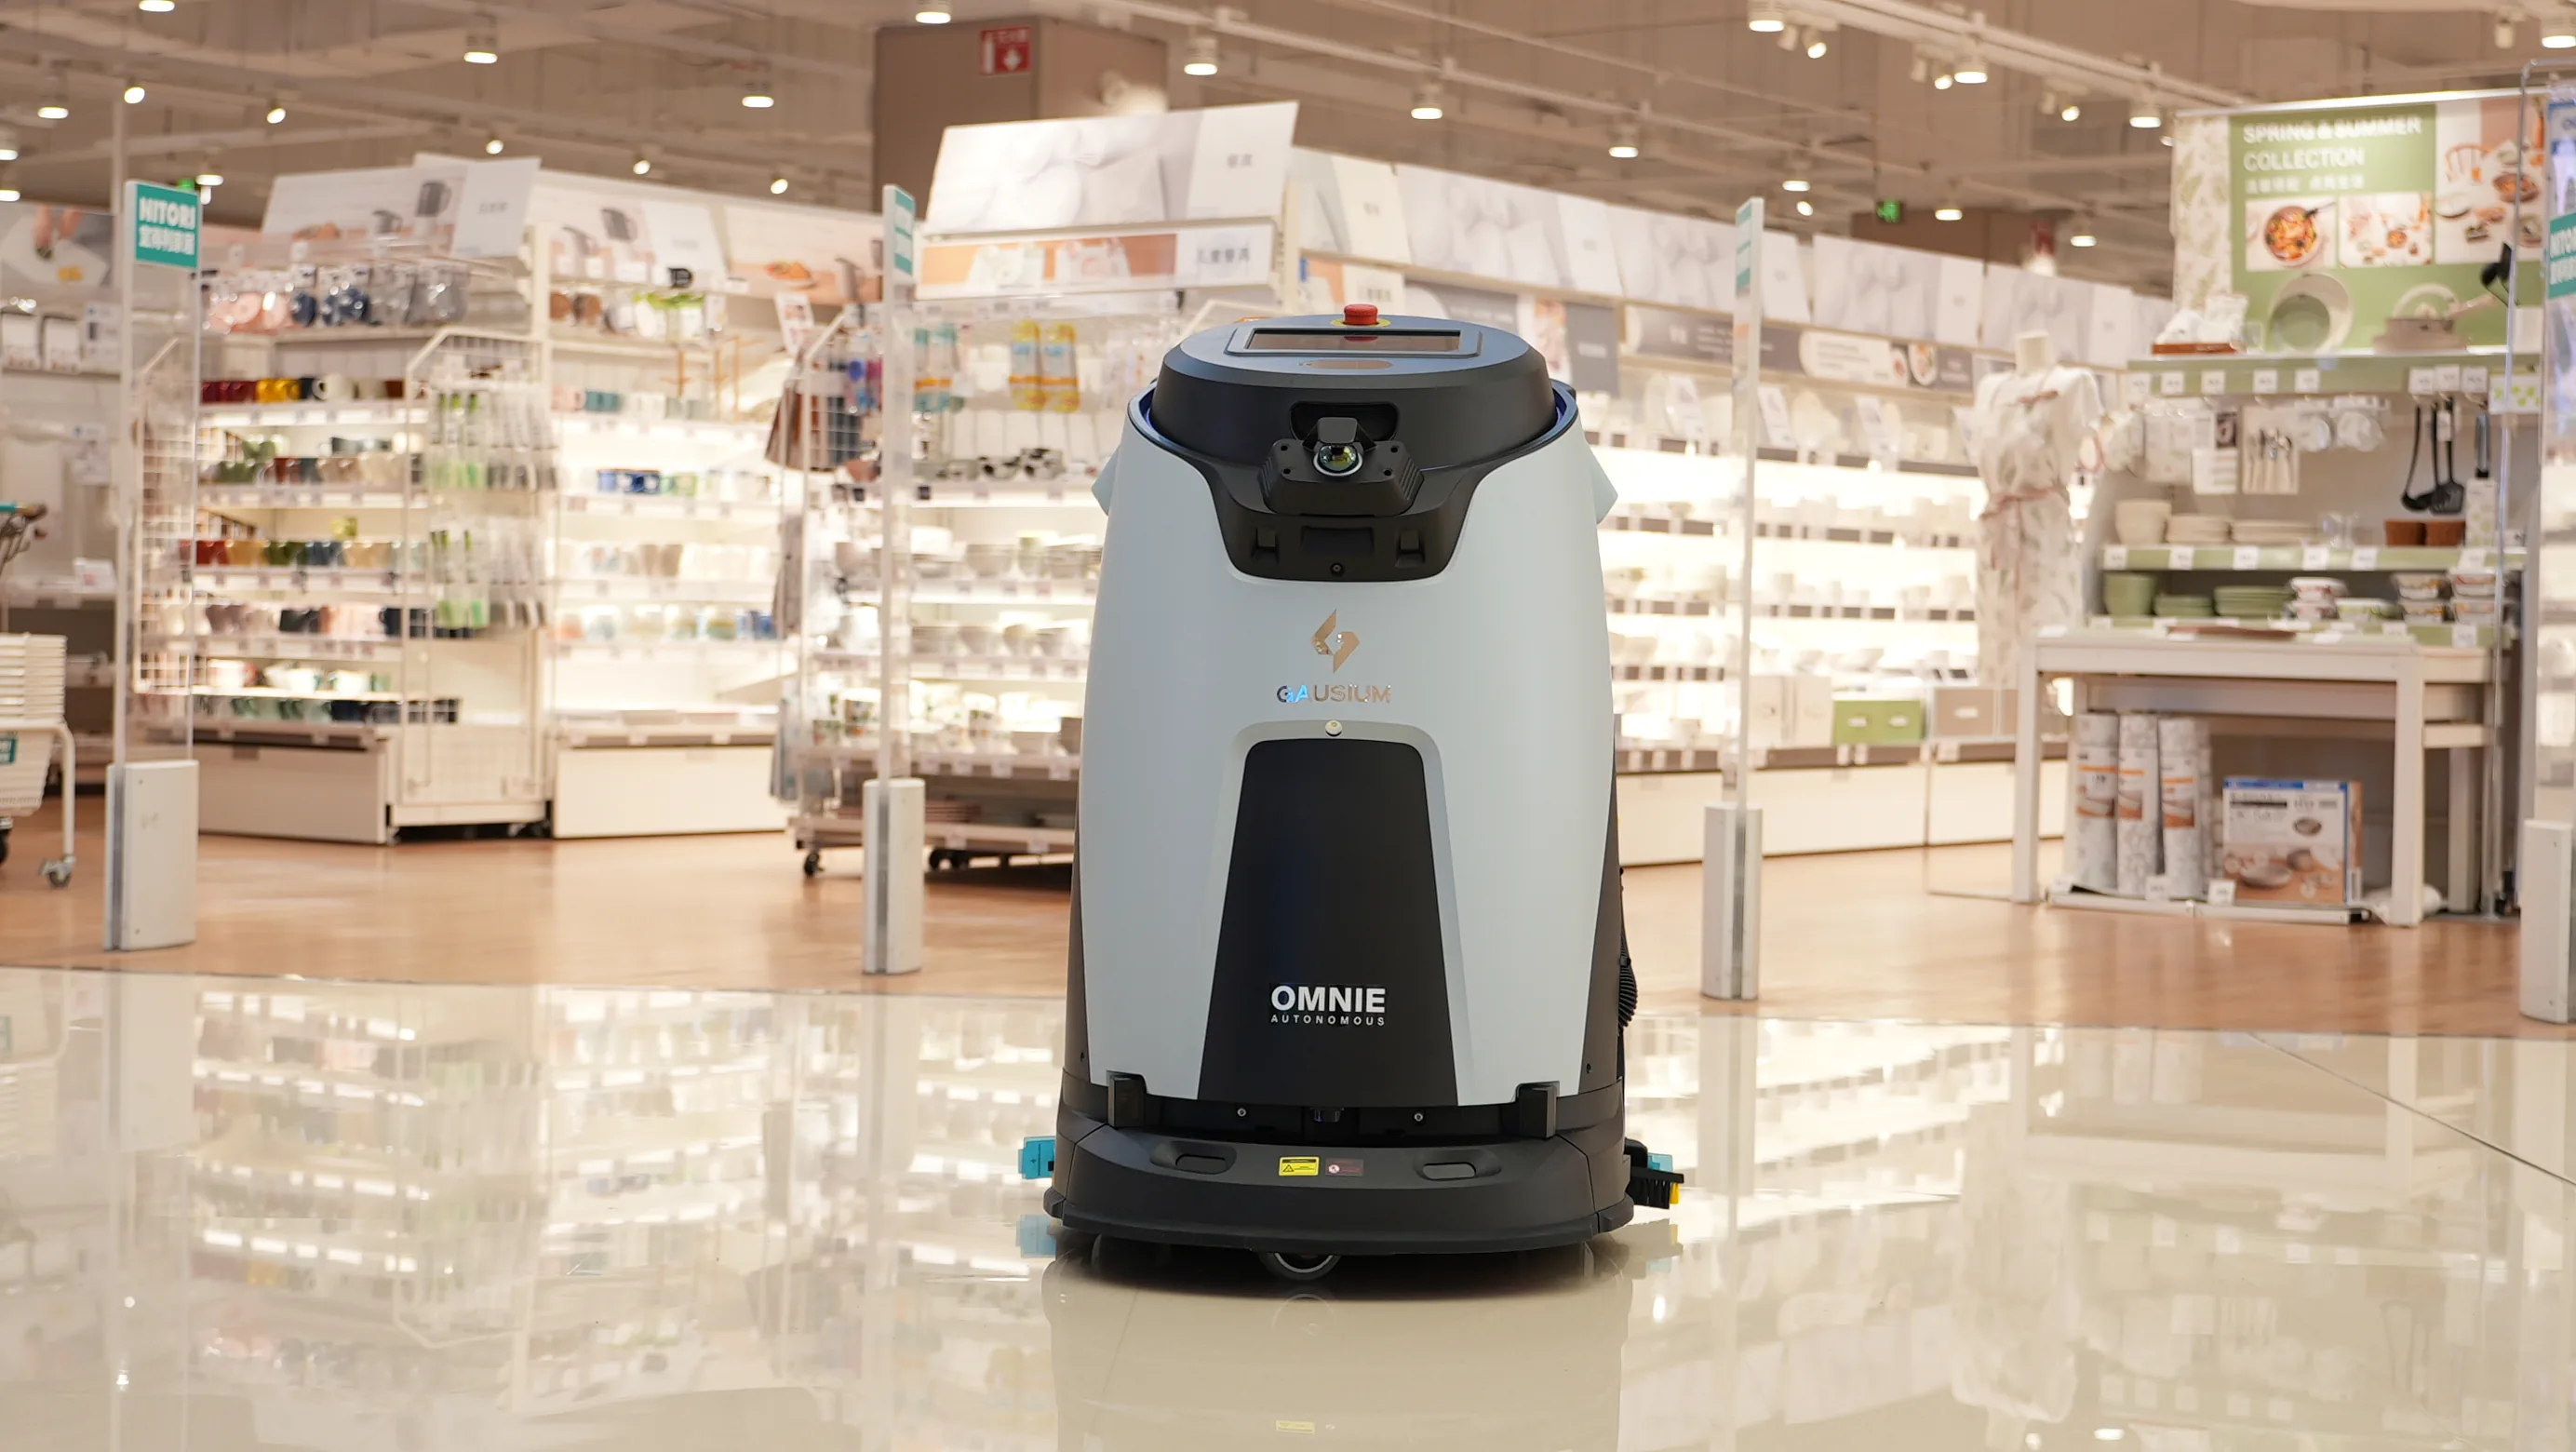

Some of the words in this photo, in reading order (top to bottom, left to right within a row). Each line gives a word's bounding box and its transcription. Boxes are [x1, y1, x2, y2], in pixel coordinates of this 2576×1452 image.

[2243, 121, 2315, 143] SPRING
[2334, 115, 2422, 139] SUMMER
[2243, 147, 2365, 171] COLLECTION
[139, 196, 196, 231] NITORI
[1276, 684, 1392, 704] GAUSIUM
[1270, 985, 1386, 1014] OMNIE
[1270, 1014, 1386, 1027] AUTONOMOUS
